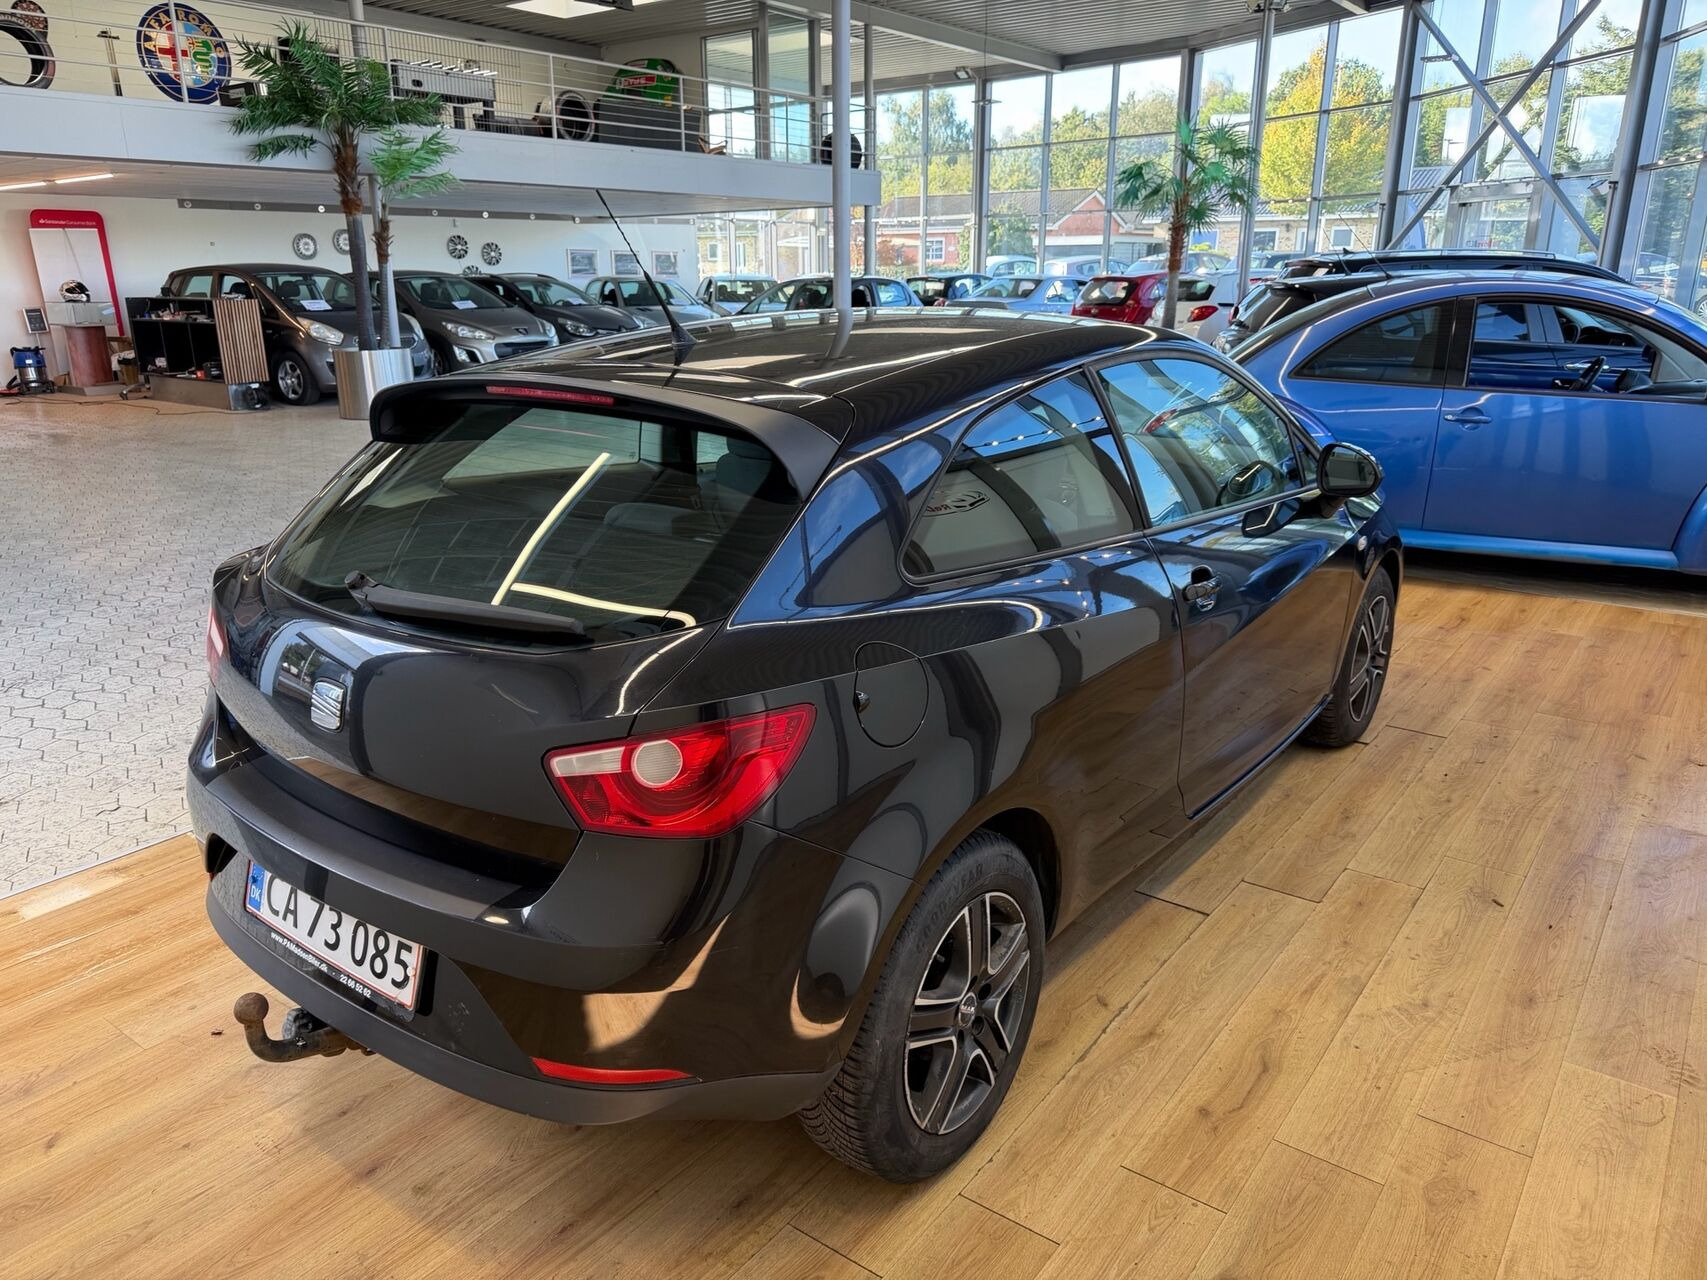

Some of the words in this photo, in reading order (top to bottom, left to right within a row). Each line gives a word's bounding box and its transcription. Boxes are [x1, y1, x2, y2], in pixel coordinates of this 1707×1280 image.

[143, 12, 172, 52] ALFA
[250, 884, 262, 902] DK
[266, 875, 298, 930] CA
[307, 896, 343, 952] 73
[350, 919, 413, 990] 085
